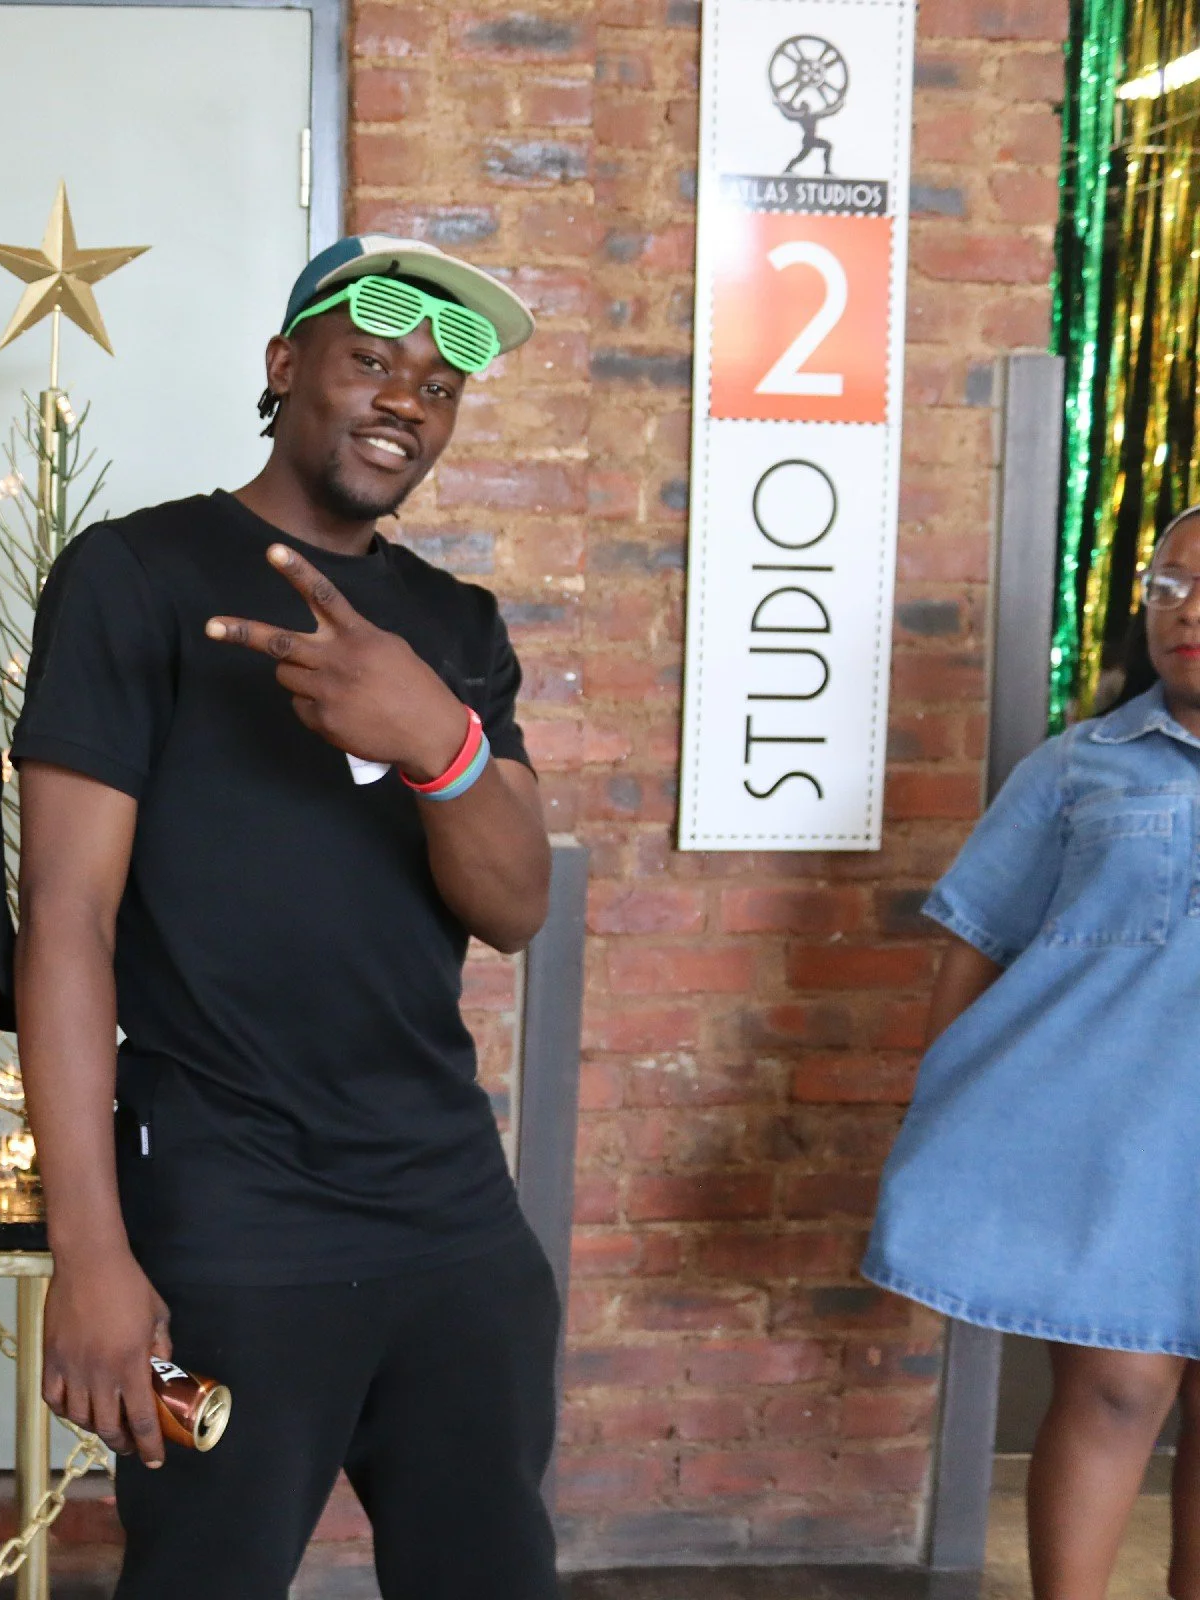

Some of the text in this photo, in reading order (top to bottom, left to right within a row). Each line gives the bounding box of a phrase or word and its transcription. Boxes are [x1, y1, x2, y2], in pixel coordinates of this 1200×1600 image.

[795, 182, 882, 208] STUDIOS
[753, 241, 848, 397] 2
[743, 458, 838, 801] STUDIO
